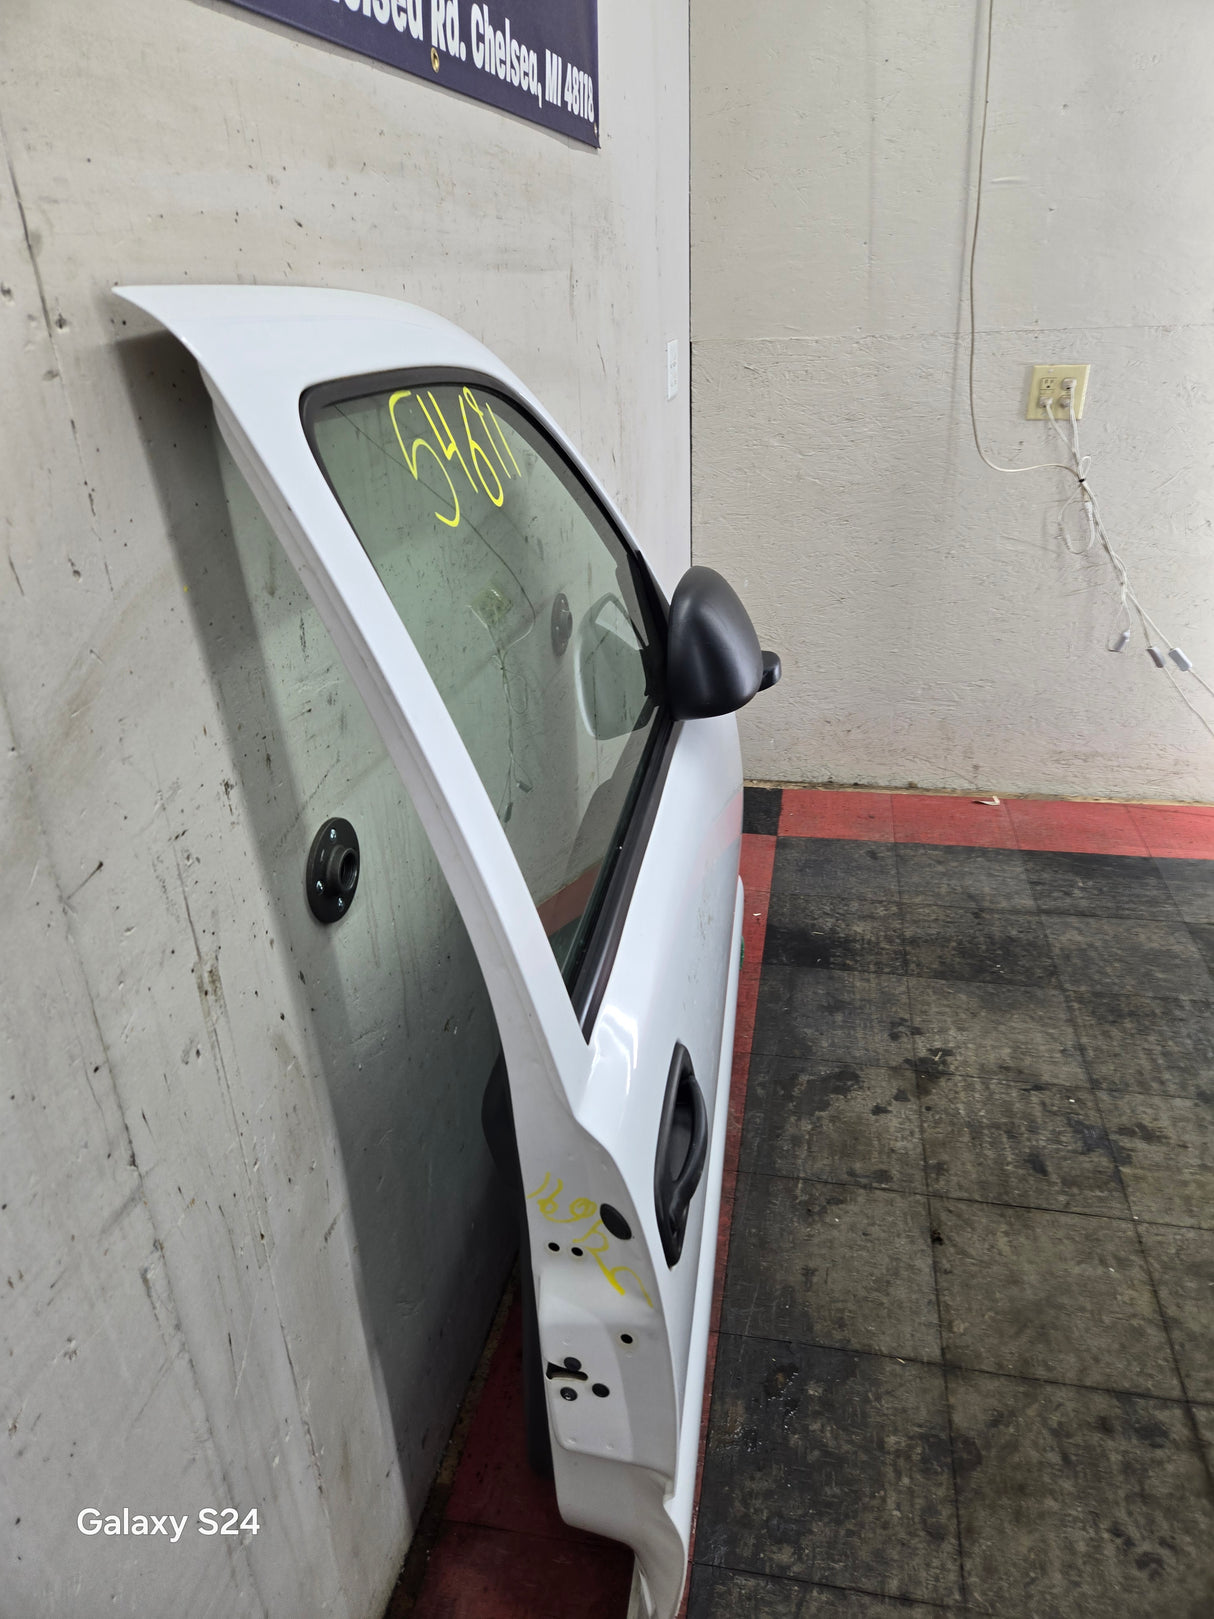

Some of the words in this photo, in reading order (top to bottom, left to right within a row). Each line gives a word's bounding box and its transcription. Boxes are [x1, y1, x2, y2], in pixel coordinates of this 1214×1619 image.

[431, 0, 466, 61] Rd.
[471, 3, 542, 108] Chelsea,
[545, 48, 562, 107] MI
[564, 62, 594, 122] 48118
